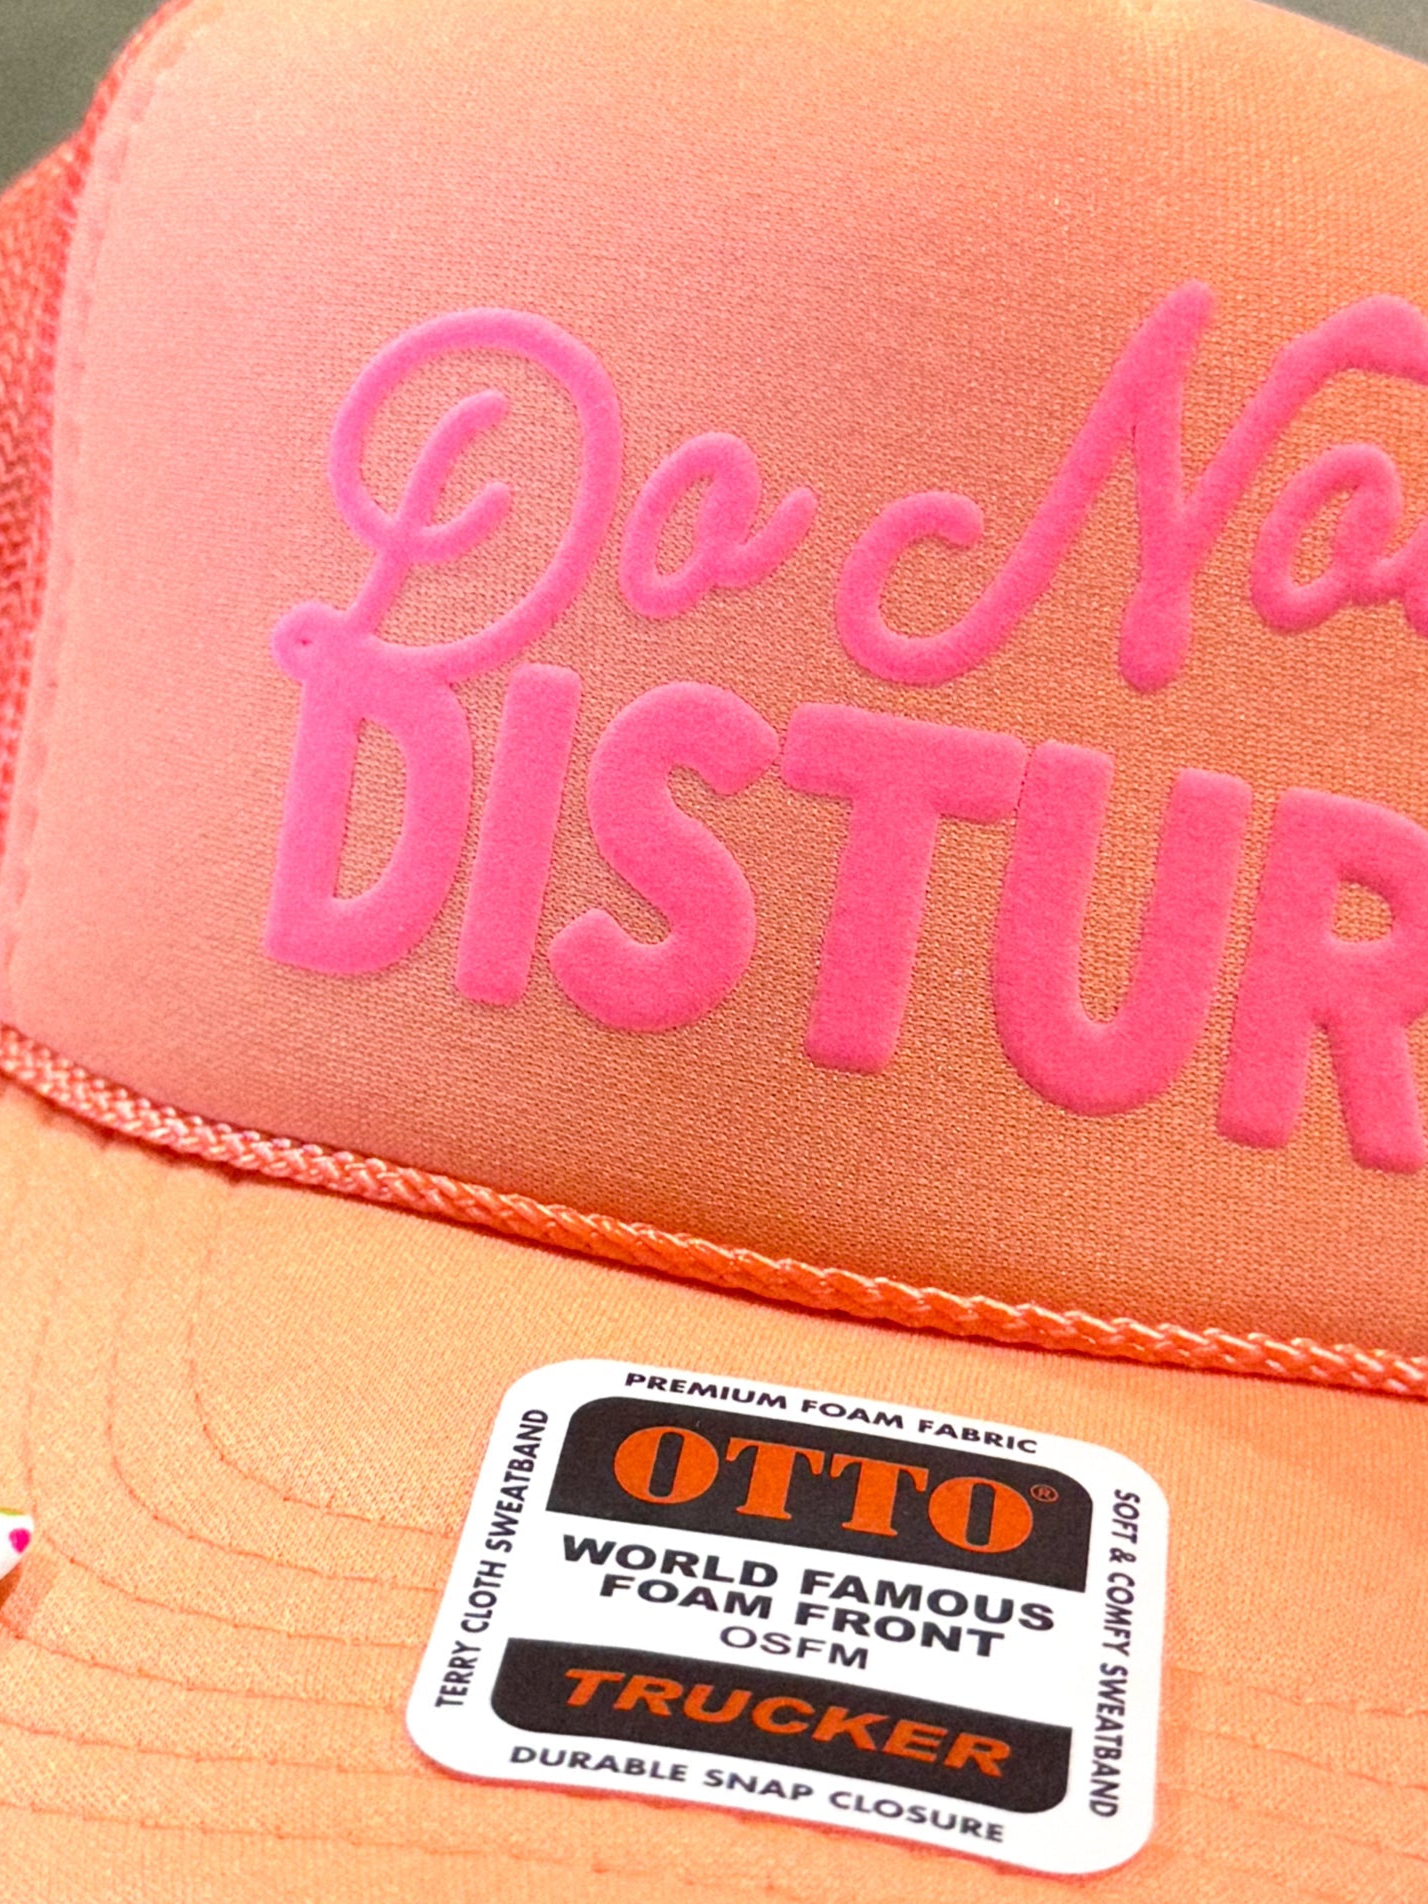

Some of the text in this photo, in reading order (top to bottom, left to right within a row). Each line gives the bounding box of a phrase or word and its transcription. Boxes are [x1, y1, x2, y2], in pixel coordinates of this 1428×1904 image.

[271, 306, 817, 686] Do
[624, 1372, 1039, 1454] PREMIUM FOAM FABRIC
[434, 1408, 549, 1708] TERRY CLOTH SWEATBAND
[562, 1534, 1055, 1632] WORLD FAMOUS
[599, 1573, 1006, 1658] FOAM FRONT
[719, 1625, 869, 1670] OSFM
[1088, 1488, 1141, 1819] SOFT & COMFY SWEATBAND
[564, 1668, 1011, 1779] TRUCKER
[509, 1745, 1005, 1844] DURABLE SNAP CLOSURE
